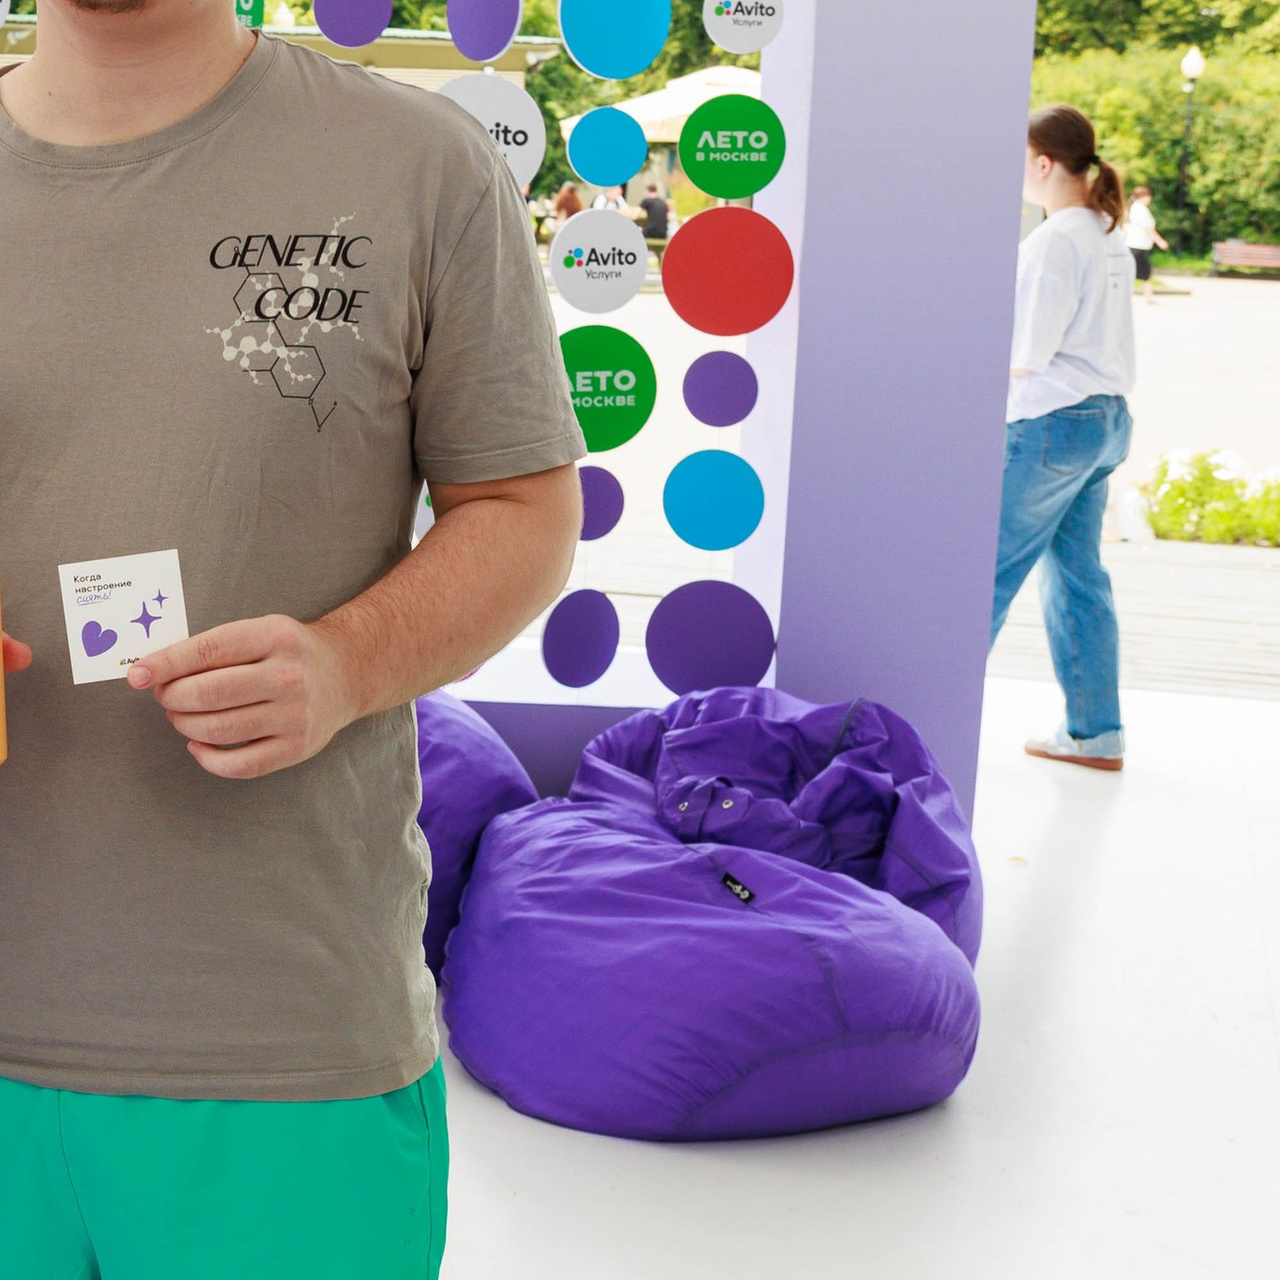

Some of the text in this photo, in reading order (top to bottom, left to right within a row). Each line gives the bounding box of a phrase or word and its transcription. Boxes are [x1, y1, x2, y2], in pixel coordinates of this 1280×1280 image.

[733, 1, 776, 17] Avito
[697, 130, 769, 149] ЛЕТО
[696, 151, 768, 162] В МОСКВЕ
[209, 234, 373, 269] GENETIC
[585, 247, 637, 267] Avito
[585, 269, 622, 281] Услуги
[254, 286, 370, 324] CODE
[73, 574, 102, 583] Когда
[75, 580, 133, 593] настроение
[76, 590, 112, 604] сиять!
